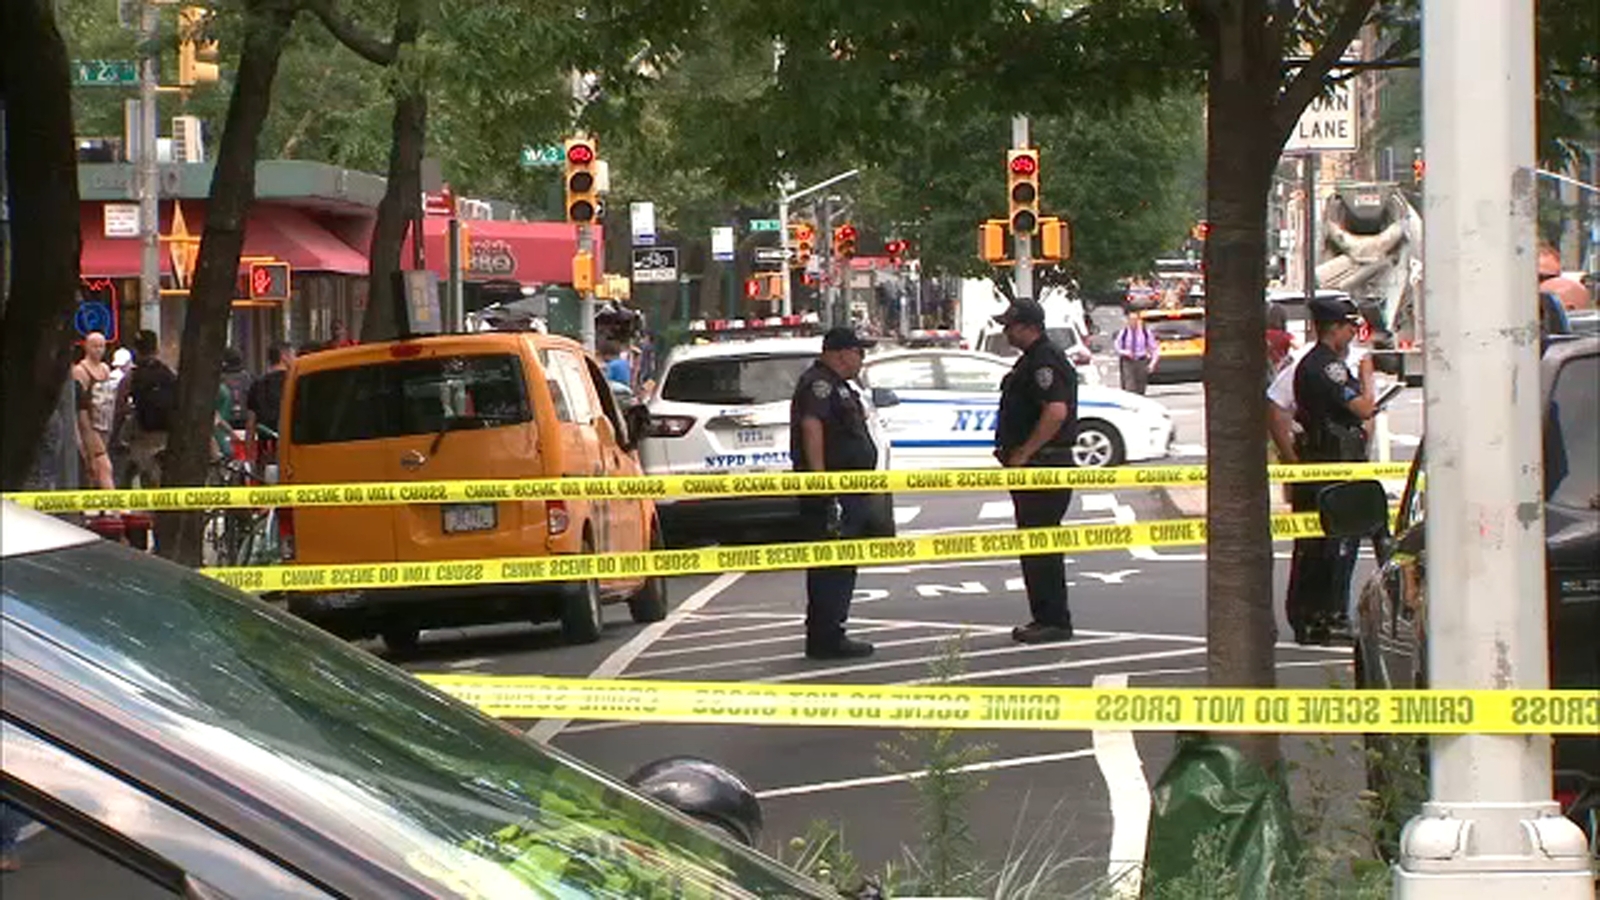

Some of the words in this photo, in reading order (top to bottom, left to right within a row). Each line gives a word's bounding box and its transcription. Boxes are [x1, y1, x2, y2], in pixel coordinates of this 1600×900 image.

[1300, 120, 1348, 138] LANE
[705, 455, 746, 466] NYPD
[752, 452, 791, 465] POLI
